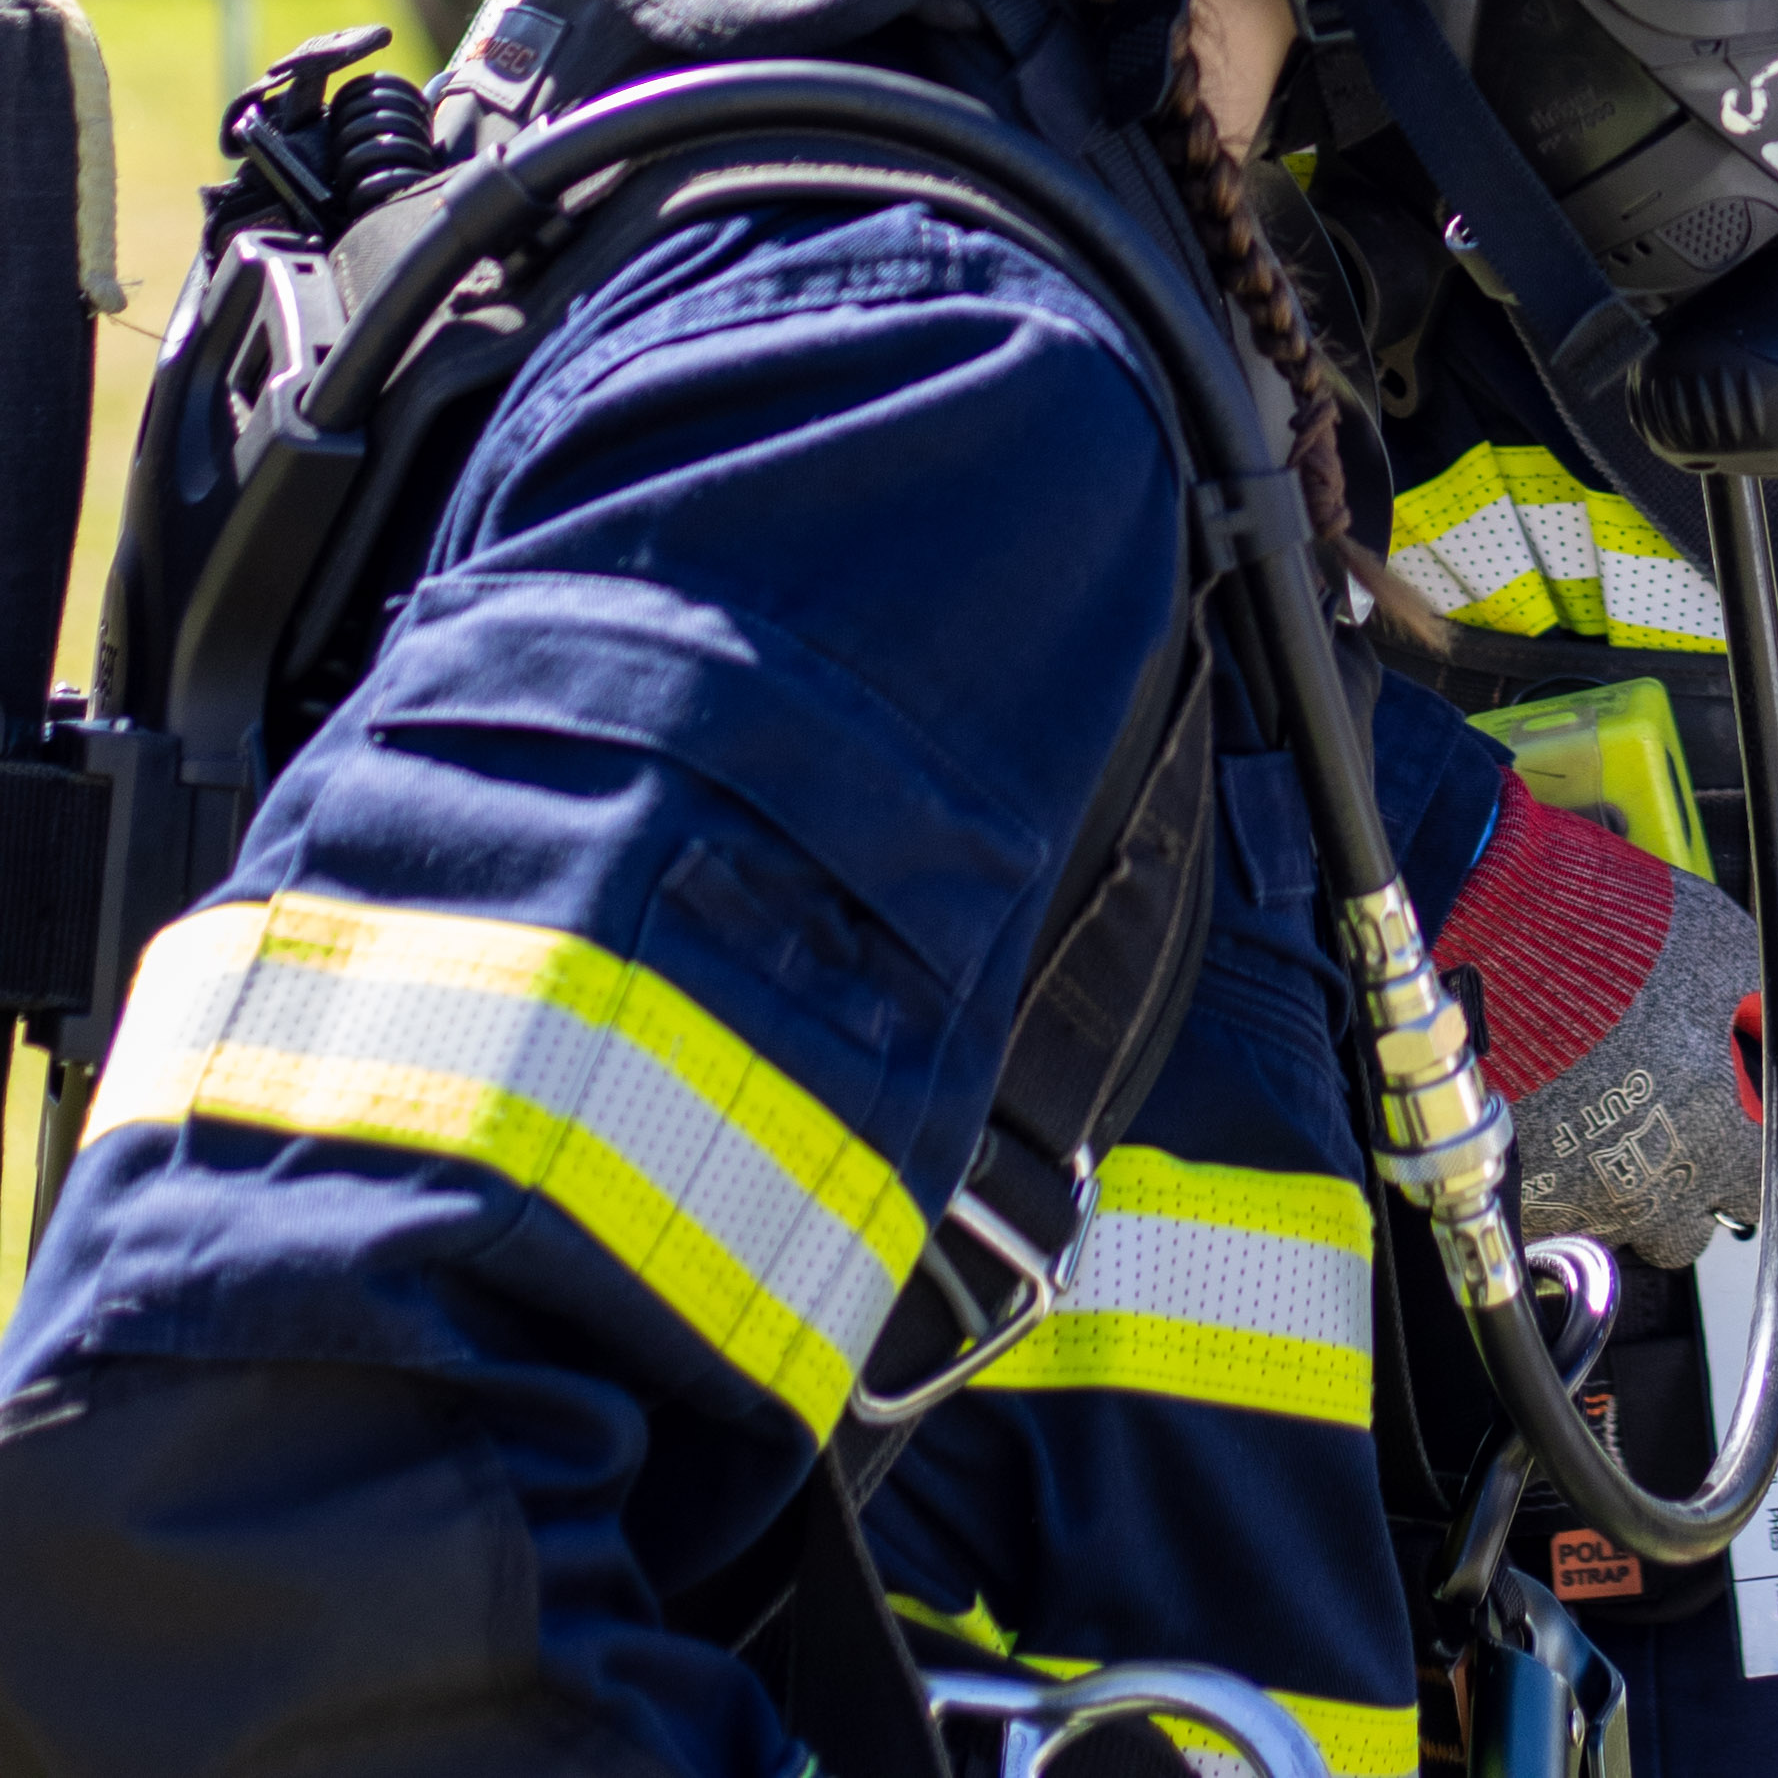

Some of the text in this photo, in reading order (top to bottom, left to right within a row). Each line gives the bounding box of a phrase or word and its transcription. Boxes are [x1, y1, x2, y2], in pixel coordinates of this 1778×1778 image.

[1552, 1069, 1653, 1158] CUT F
[1561, 1565, 1631, 1587] STRAP
